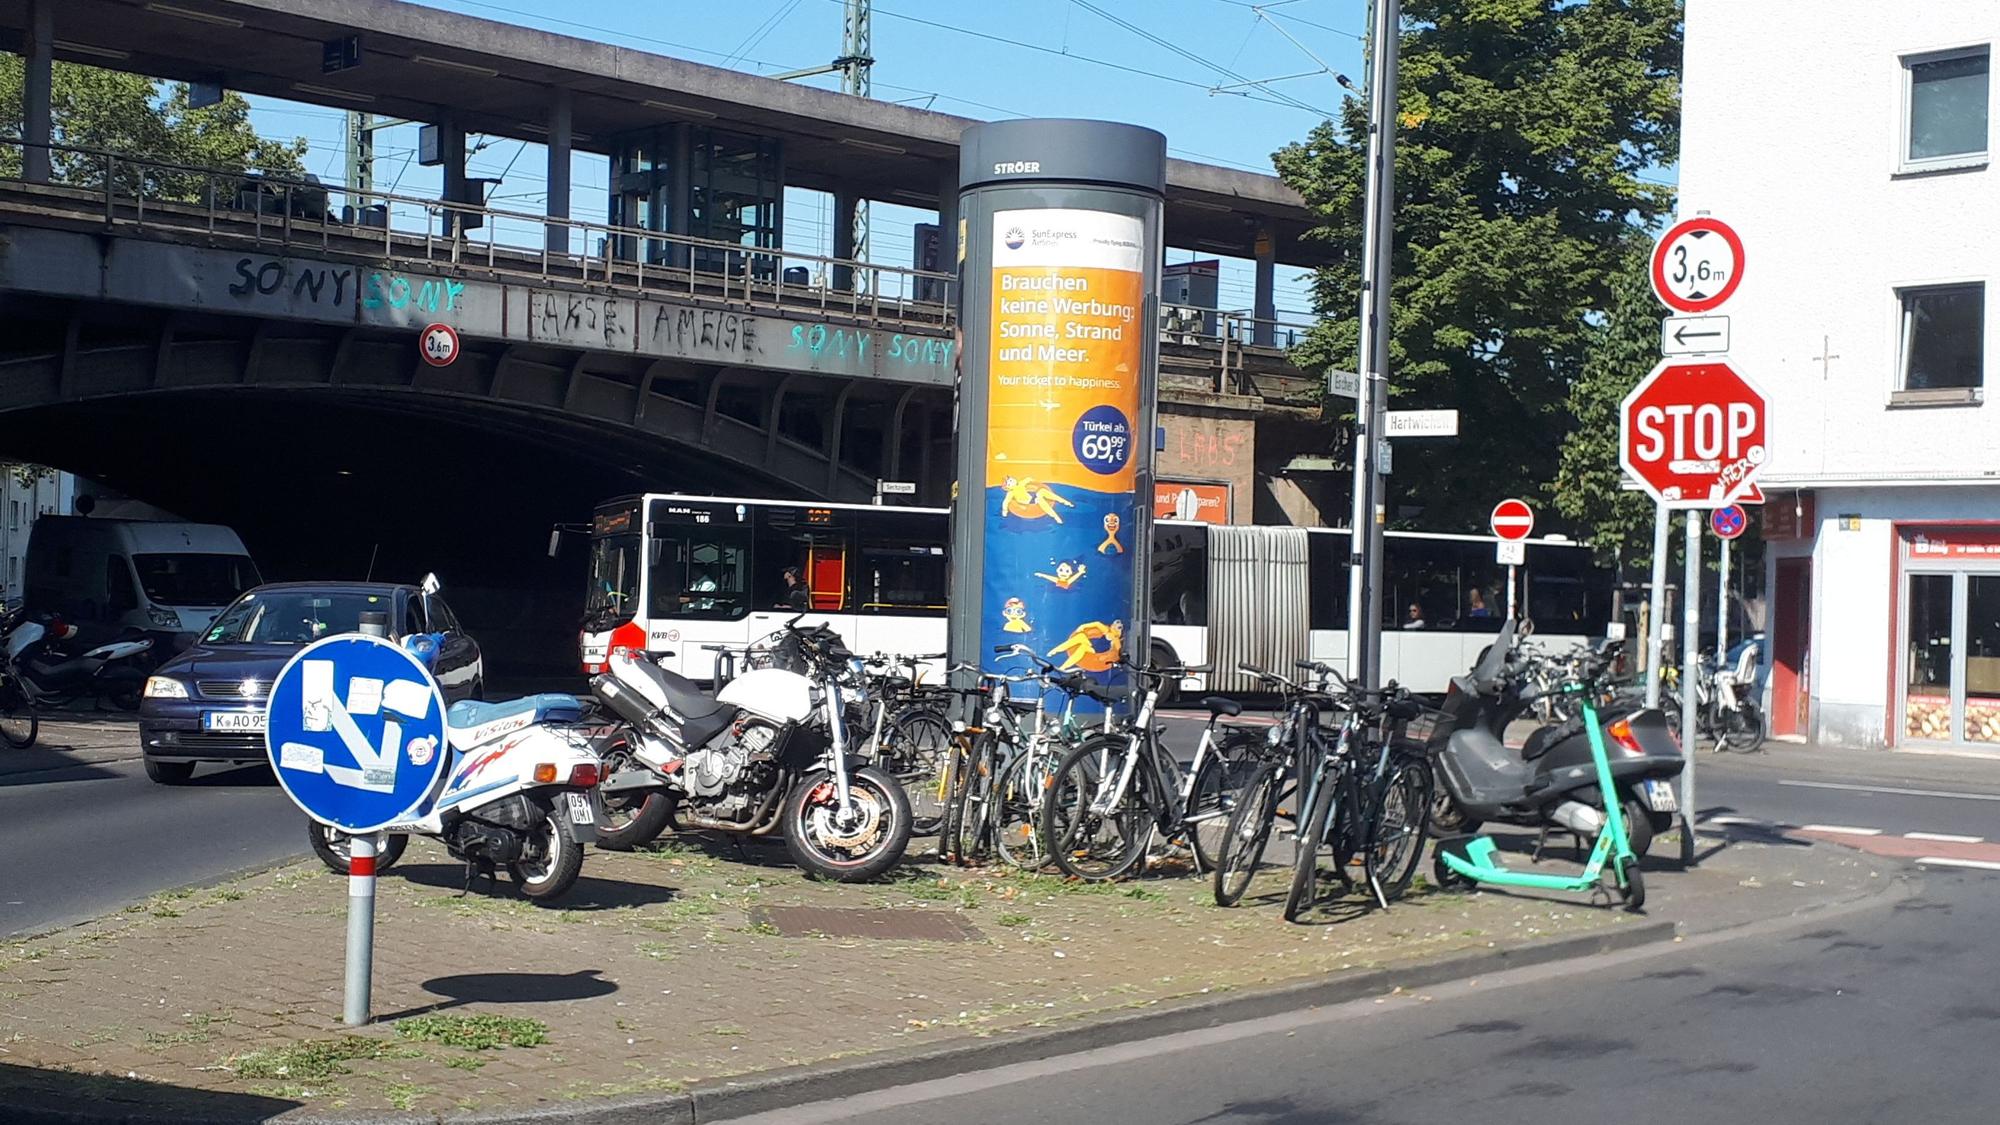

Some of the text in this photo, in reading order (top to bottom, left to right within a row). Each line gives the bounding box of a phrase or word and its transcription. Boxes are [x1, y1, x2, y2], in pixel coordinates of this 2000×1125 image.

[994, 161, 1040, 174] STRÖER
[1032, 230, 1077, 240] SunExpress
[229, 258, 350, 306] SONY
[1001, 274, 1087, 291] Brauchen
[363, 272, 465, 313] SONY
[1001, 298, 1135, 323] keine Werbung:
[1000, 321, 1121, 341] Sonne, Strand
[787, 323, 953, 368] SONY SONY
[999, 345, 1089, 362] und Meer.
[998, 375, 1021, 386] Your
[1023, 375, 1052, 386] ticket
[1055, 376, 1066, 386] to
[1082, 421, 1125, 433] Türkei ab
[1636, 402, 1756, 462] STOP
[651, 631, 668, 640] KVB
[216, 715, 224, 727] K
